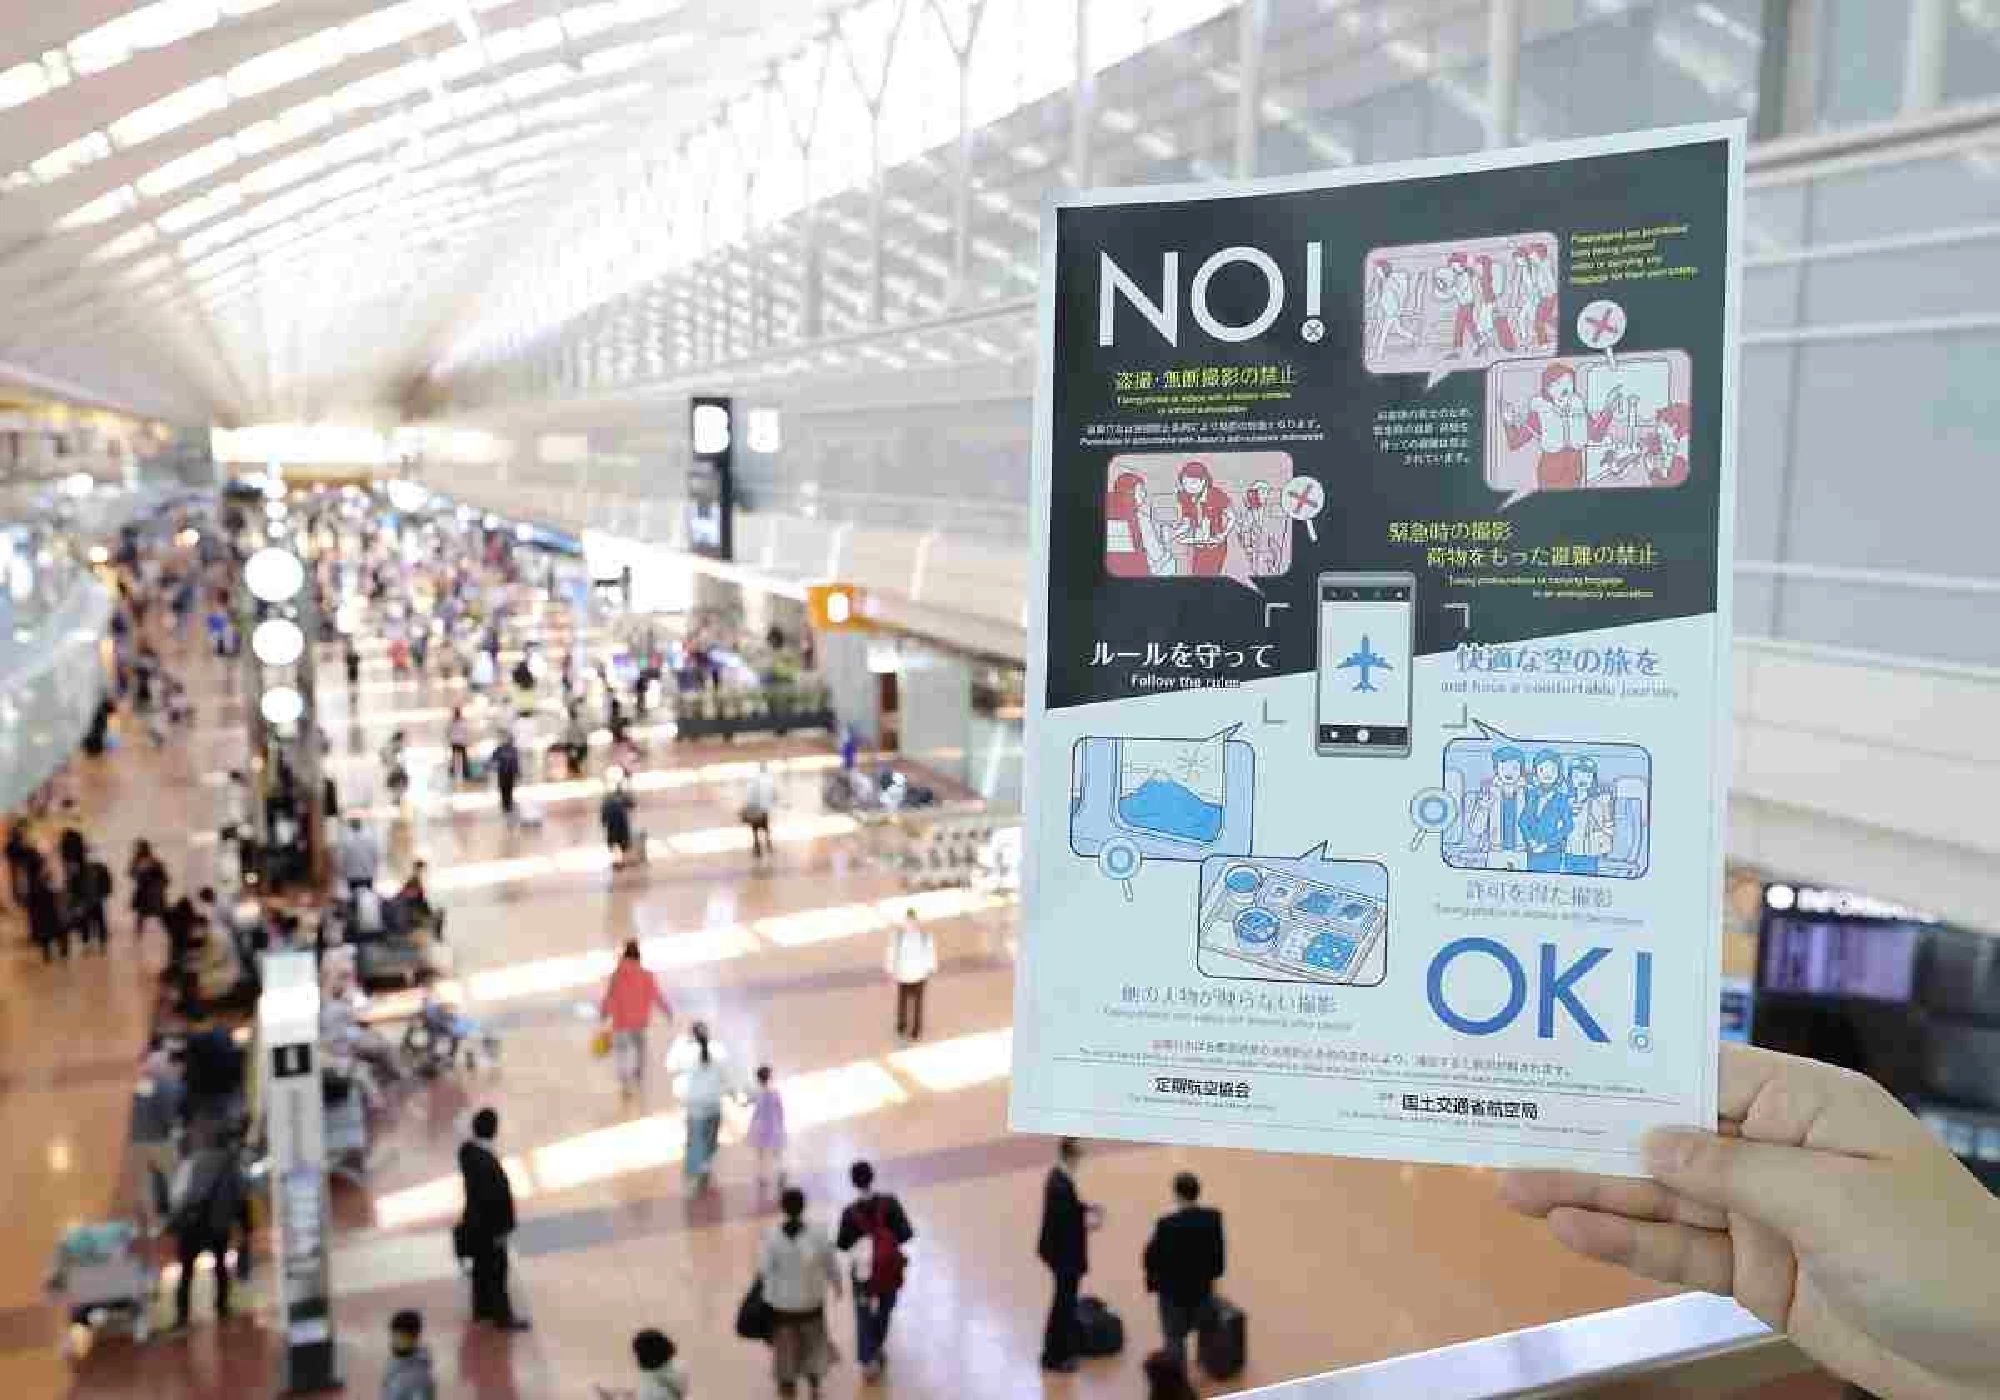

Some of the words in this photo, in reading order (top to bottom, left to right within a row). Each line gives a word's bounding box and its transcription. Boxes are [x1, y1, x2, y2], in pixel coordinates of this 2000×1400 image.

[1099, 241, 1326, 348] NO!
[1090, 641, 1275, 669] ルールを守って
[1455, 642, 1659, 676] 快適な空の旅を
[1131, 672, 1176, 691] Follow
[1427, 936, 1653, 1051] OK!
[1402, 1094, 1538, 1120] 国土交通省航空局
